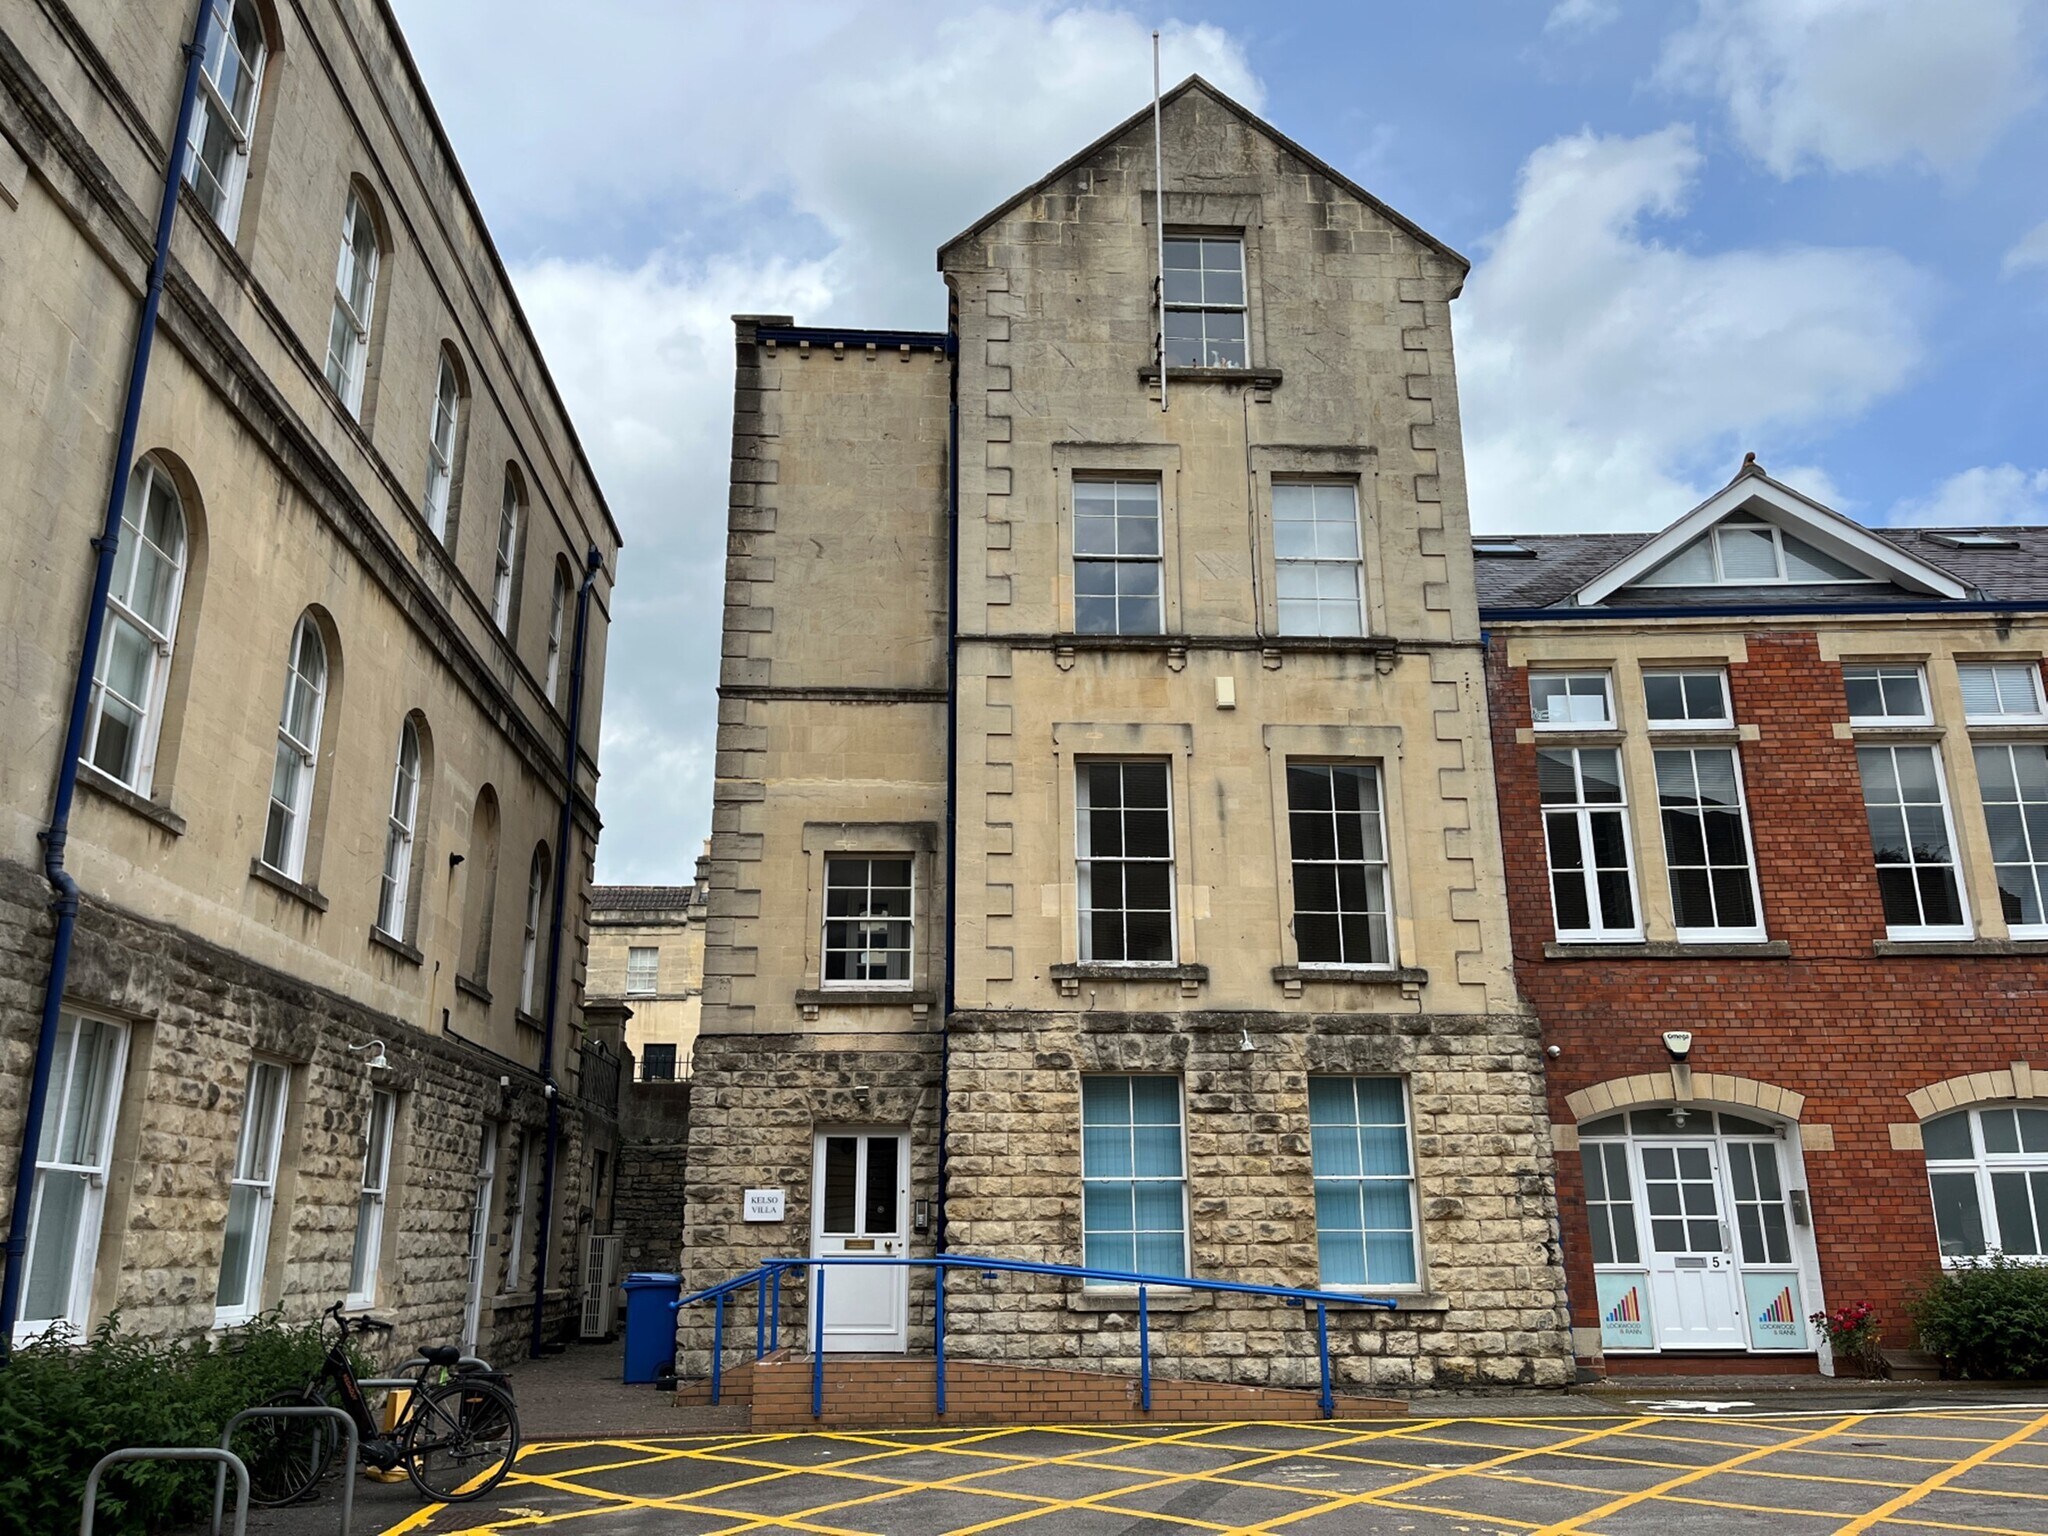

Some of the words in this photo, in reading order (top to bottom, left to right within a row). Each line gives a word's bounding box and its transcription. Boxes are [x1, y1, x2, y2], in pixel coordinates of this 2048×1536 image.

[751, 1196, 779, 1204] KELSO
[752, 1206, 777, 1214] VILLA
[1712, 1256, 1720, 1268] 5
